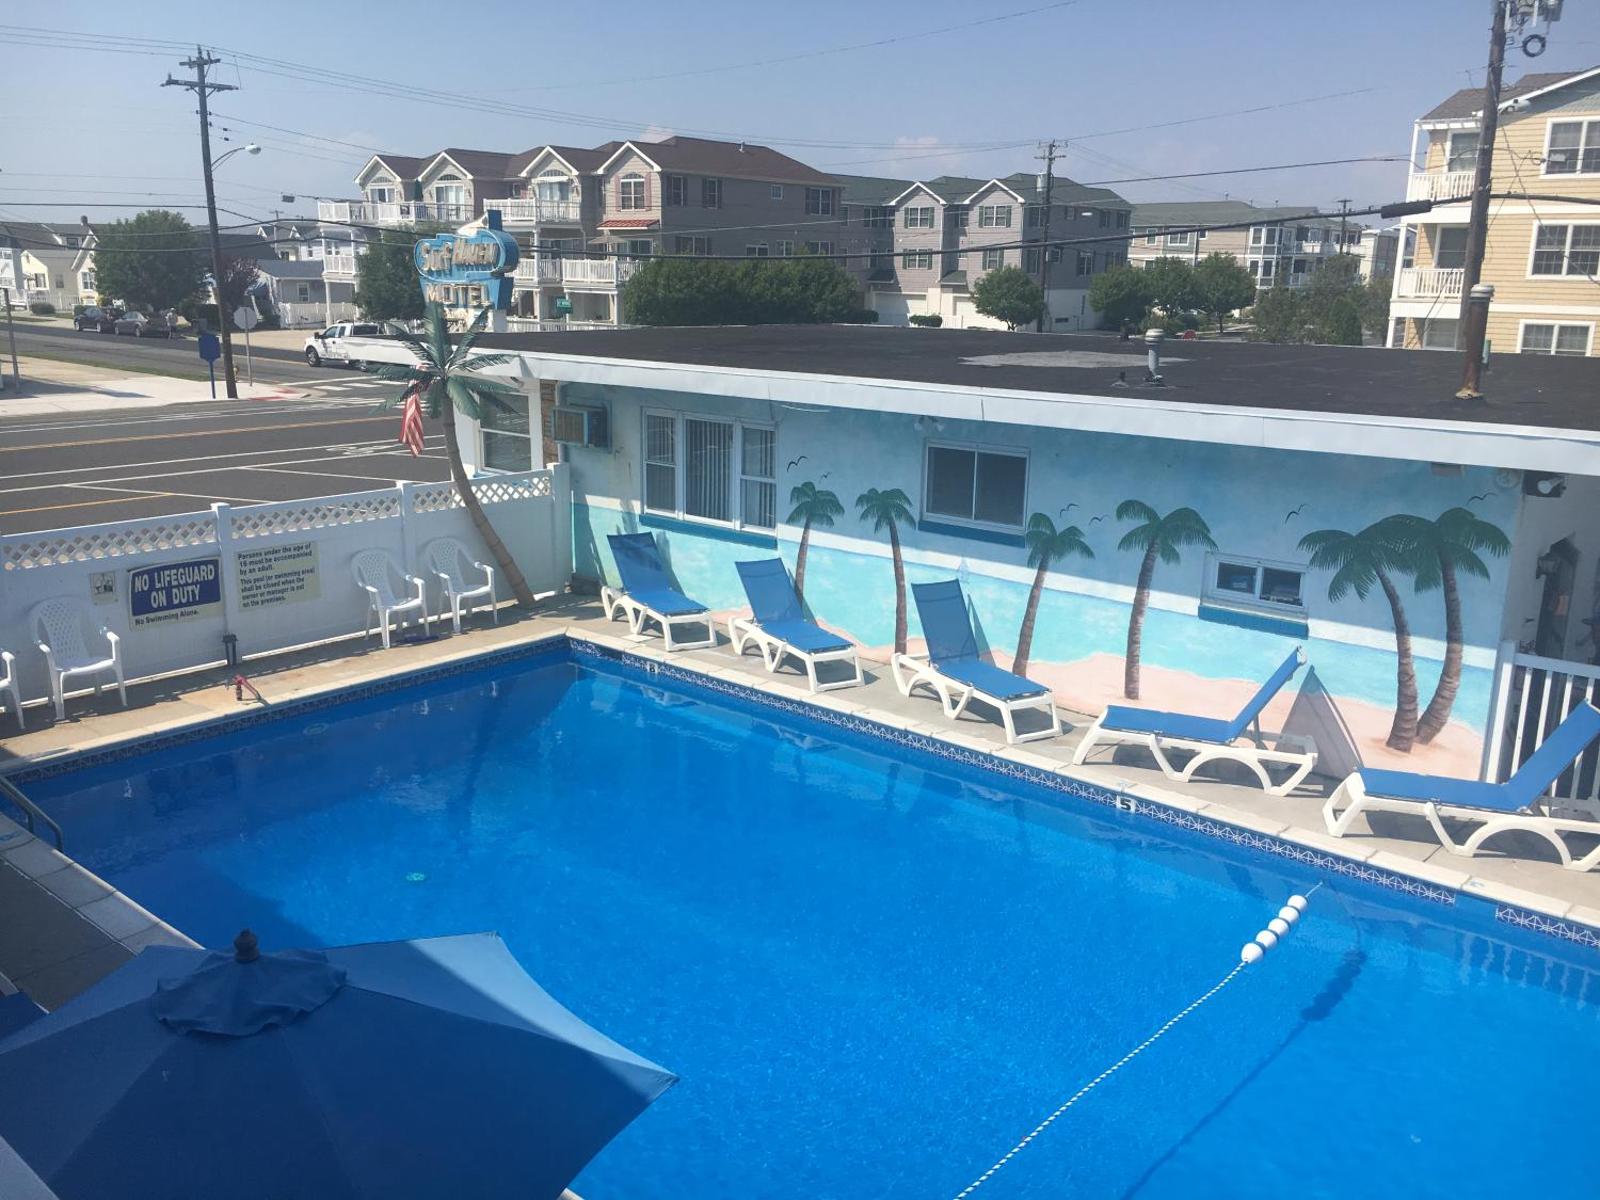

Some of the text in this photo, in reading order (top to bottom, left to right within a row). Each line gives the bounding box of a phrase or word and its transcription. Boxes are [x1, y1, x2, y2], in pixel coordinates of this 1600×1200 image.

[425, 282, 492, 307] MOTEL
[238, 552, 262, 560] Persons
[274, 550, 312, 561] accompanied
[134, 564, 215, 592] NO LIFEGUARD
[151, 584, 200, 608] ON DUTY
[145, 613, 178, 623] Swimming
[1121, 798, 1132, 811] 5
